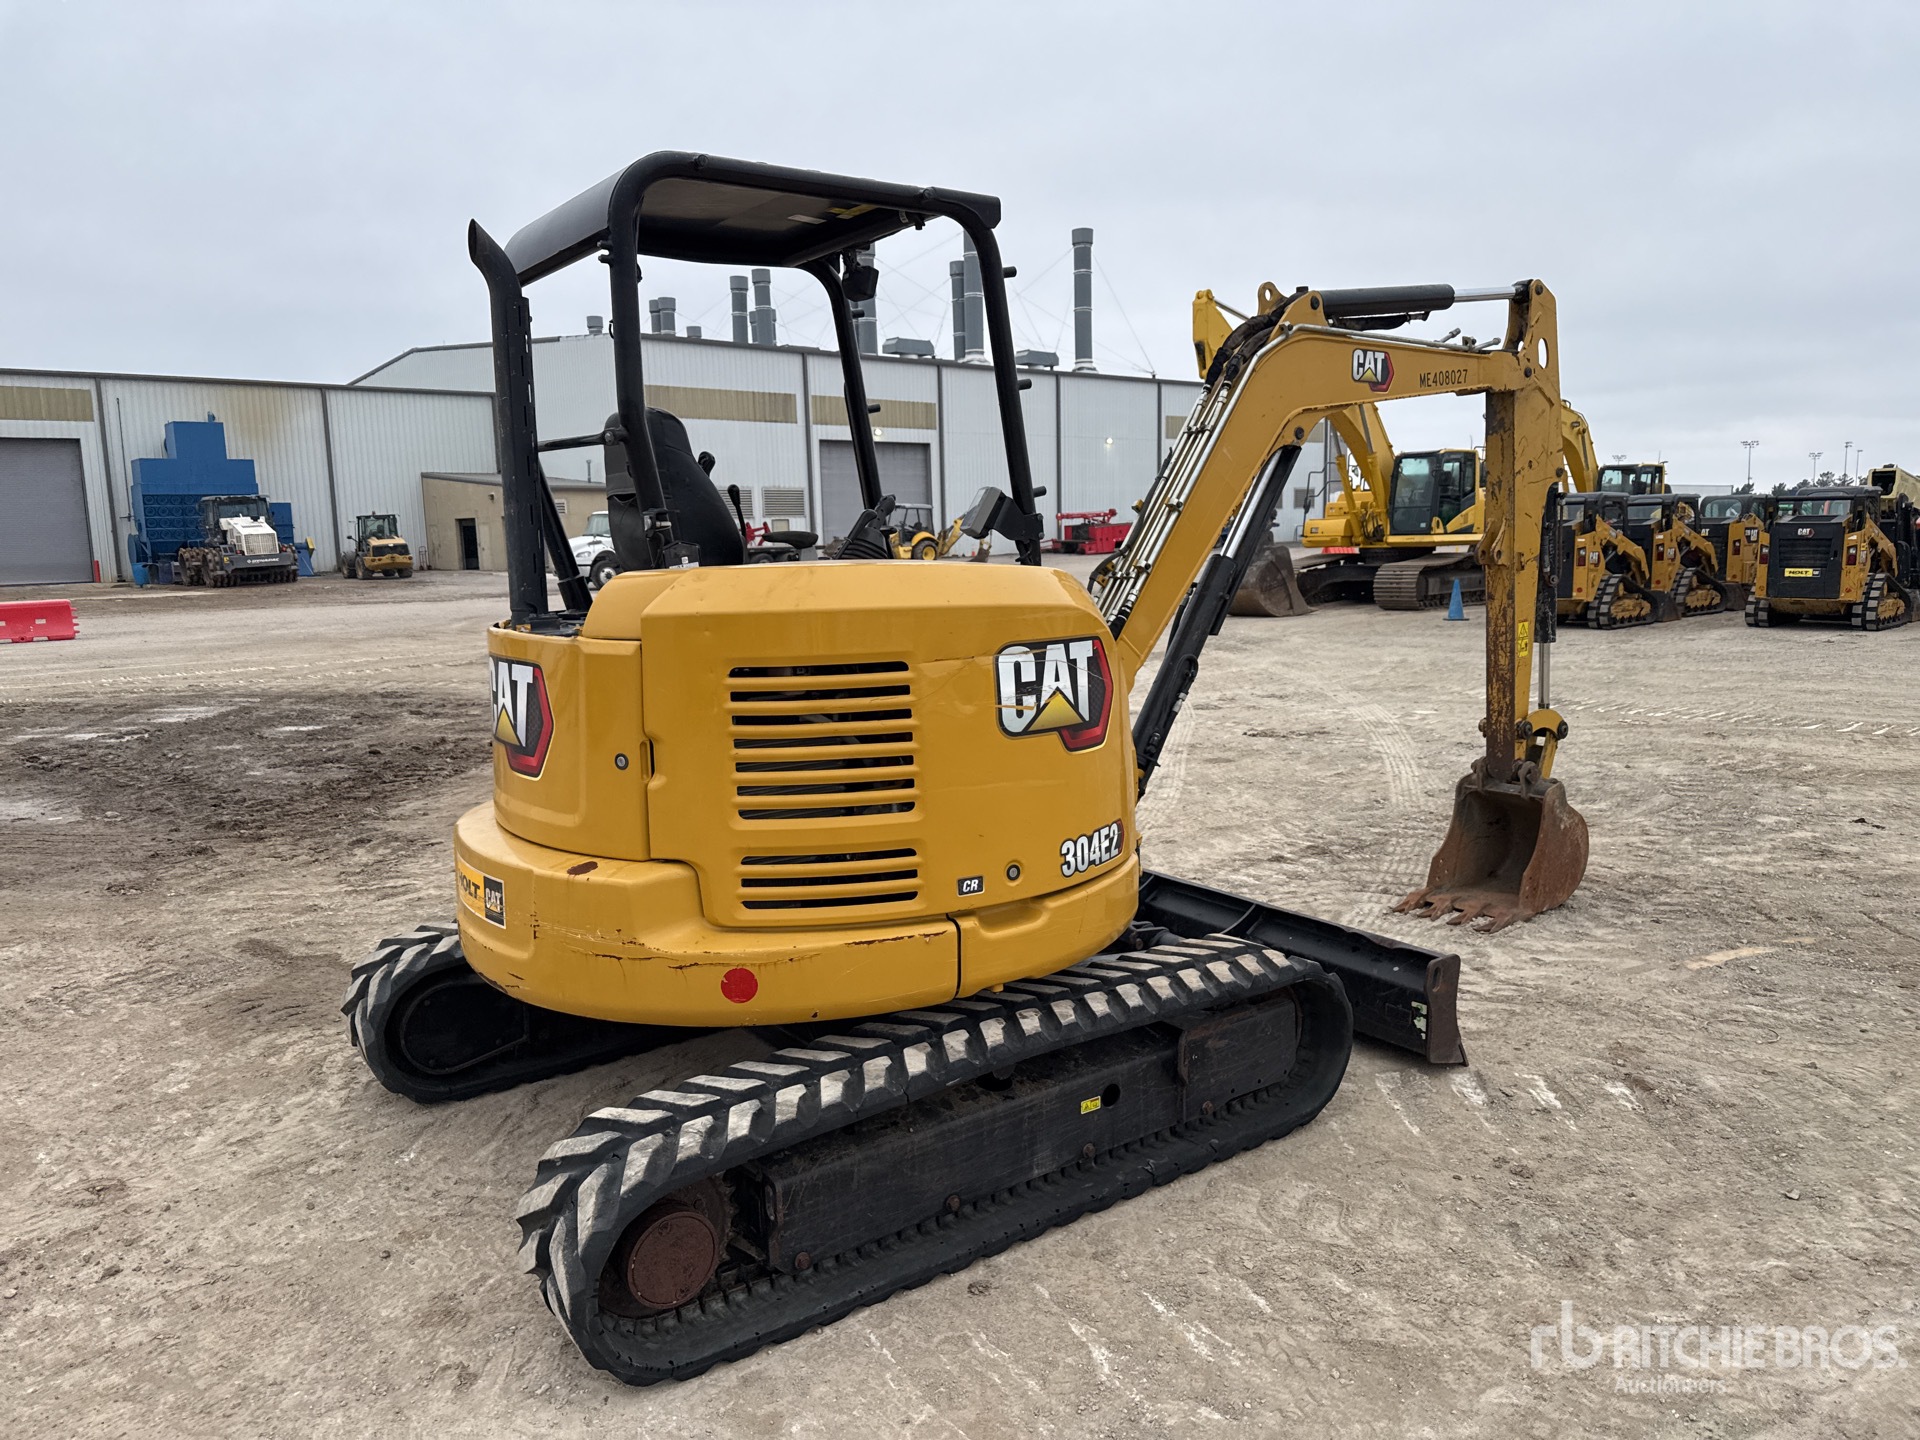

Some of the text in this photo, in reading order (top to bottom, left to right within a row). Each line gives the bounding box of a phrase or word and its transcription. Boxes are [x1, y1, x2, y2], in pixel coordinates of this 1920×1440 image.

[1353, 350, 1385, 382] CAT
[1420, 369, 1468, 387] ME408027
[1589, 551, 1599, 564] CAT
[998, 639, 1094, 733] CAT
[1061, 822, 1119, 877] 304E2
[962, 880, 979, 893] CR
[485, 887, 502, 913] CAT
